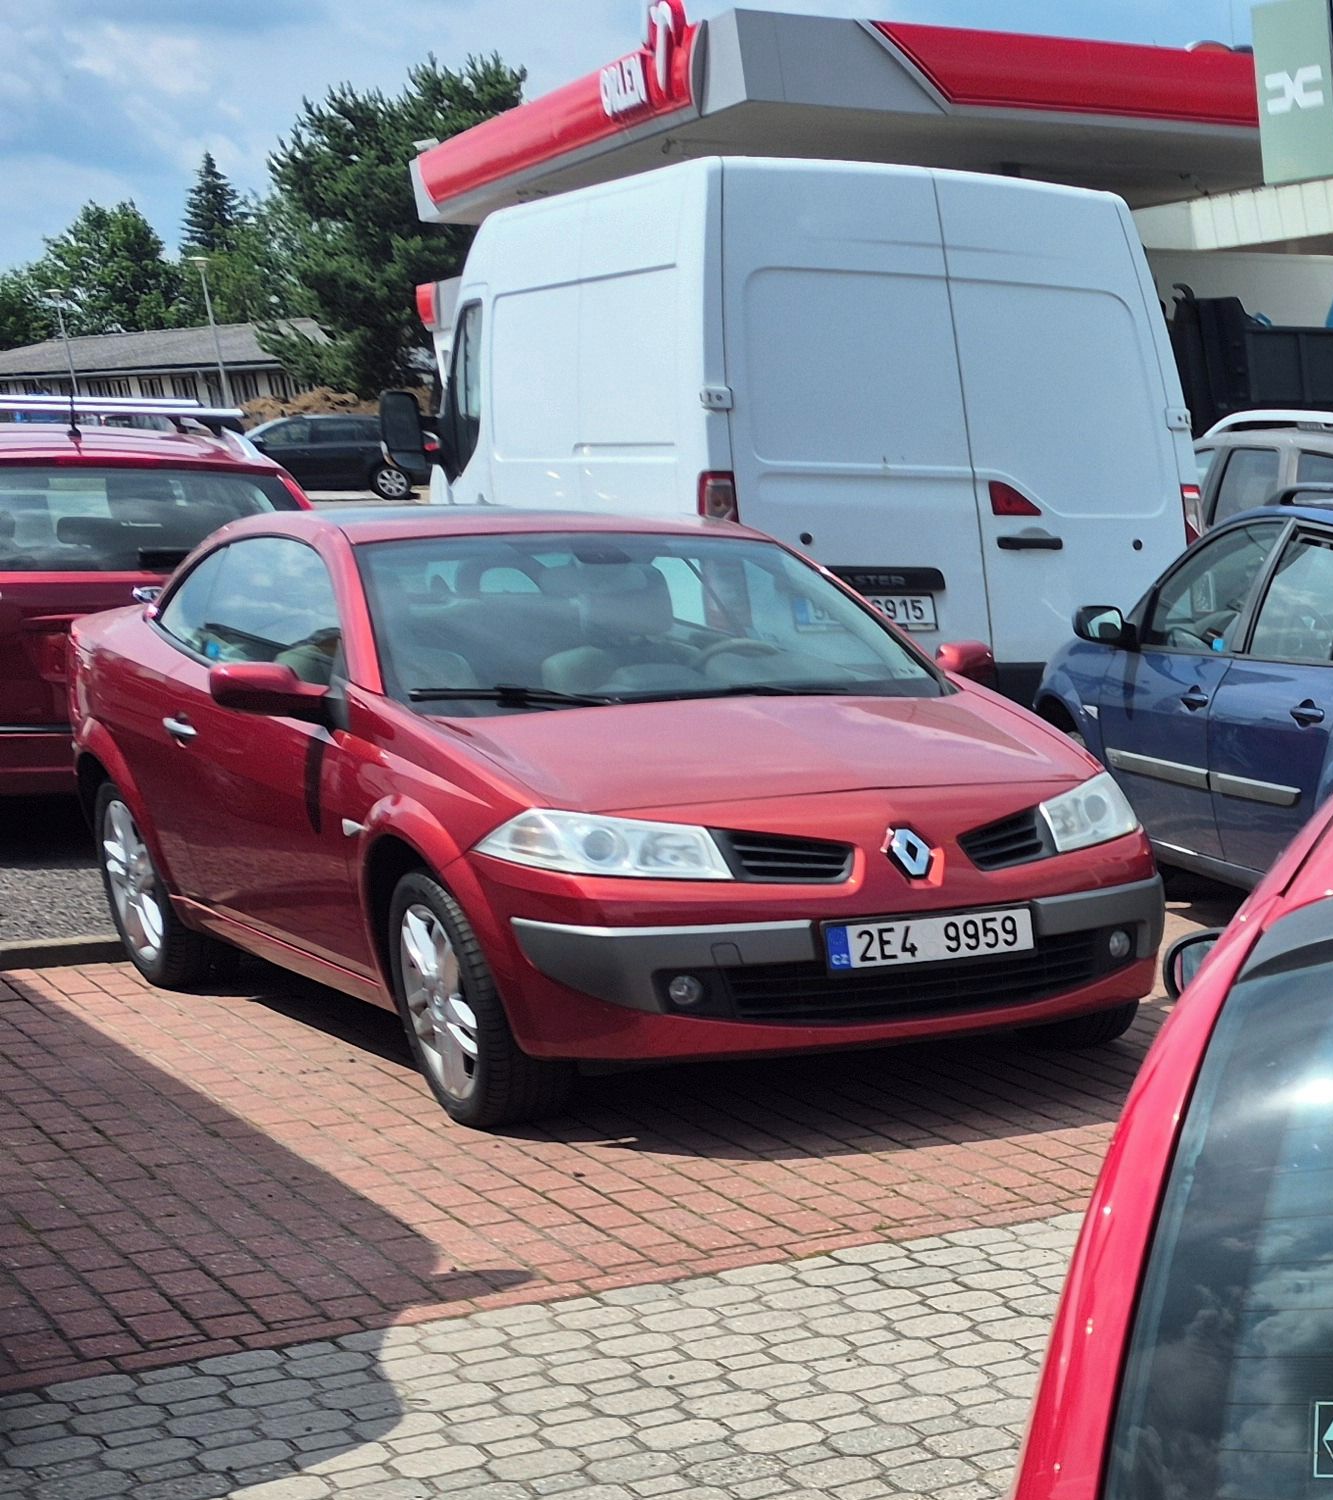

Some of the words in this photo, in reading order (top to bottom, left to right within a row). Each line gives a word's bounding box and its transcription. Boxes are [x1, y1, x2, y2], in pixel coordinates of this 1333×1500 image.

[831, 953, 850, 966] CZ
[857, 926, 918, 962] 2E4
[944, 916, 1018, 953] 9959
